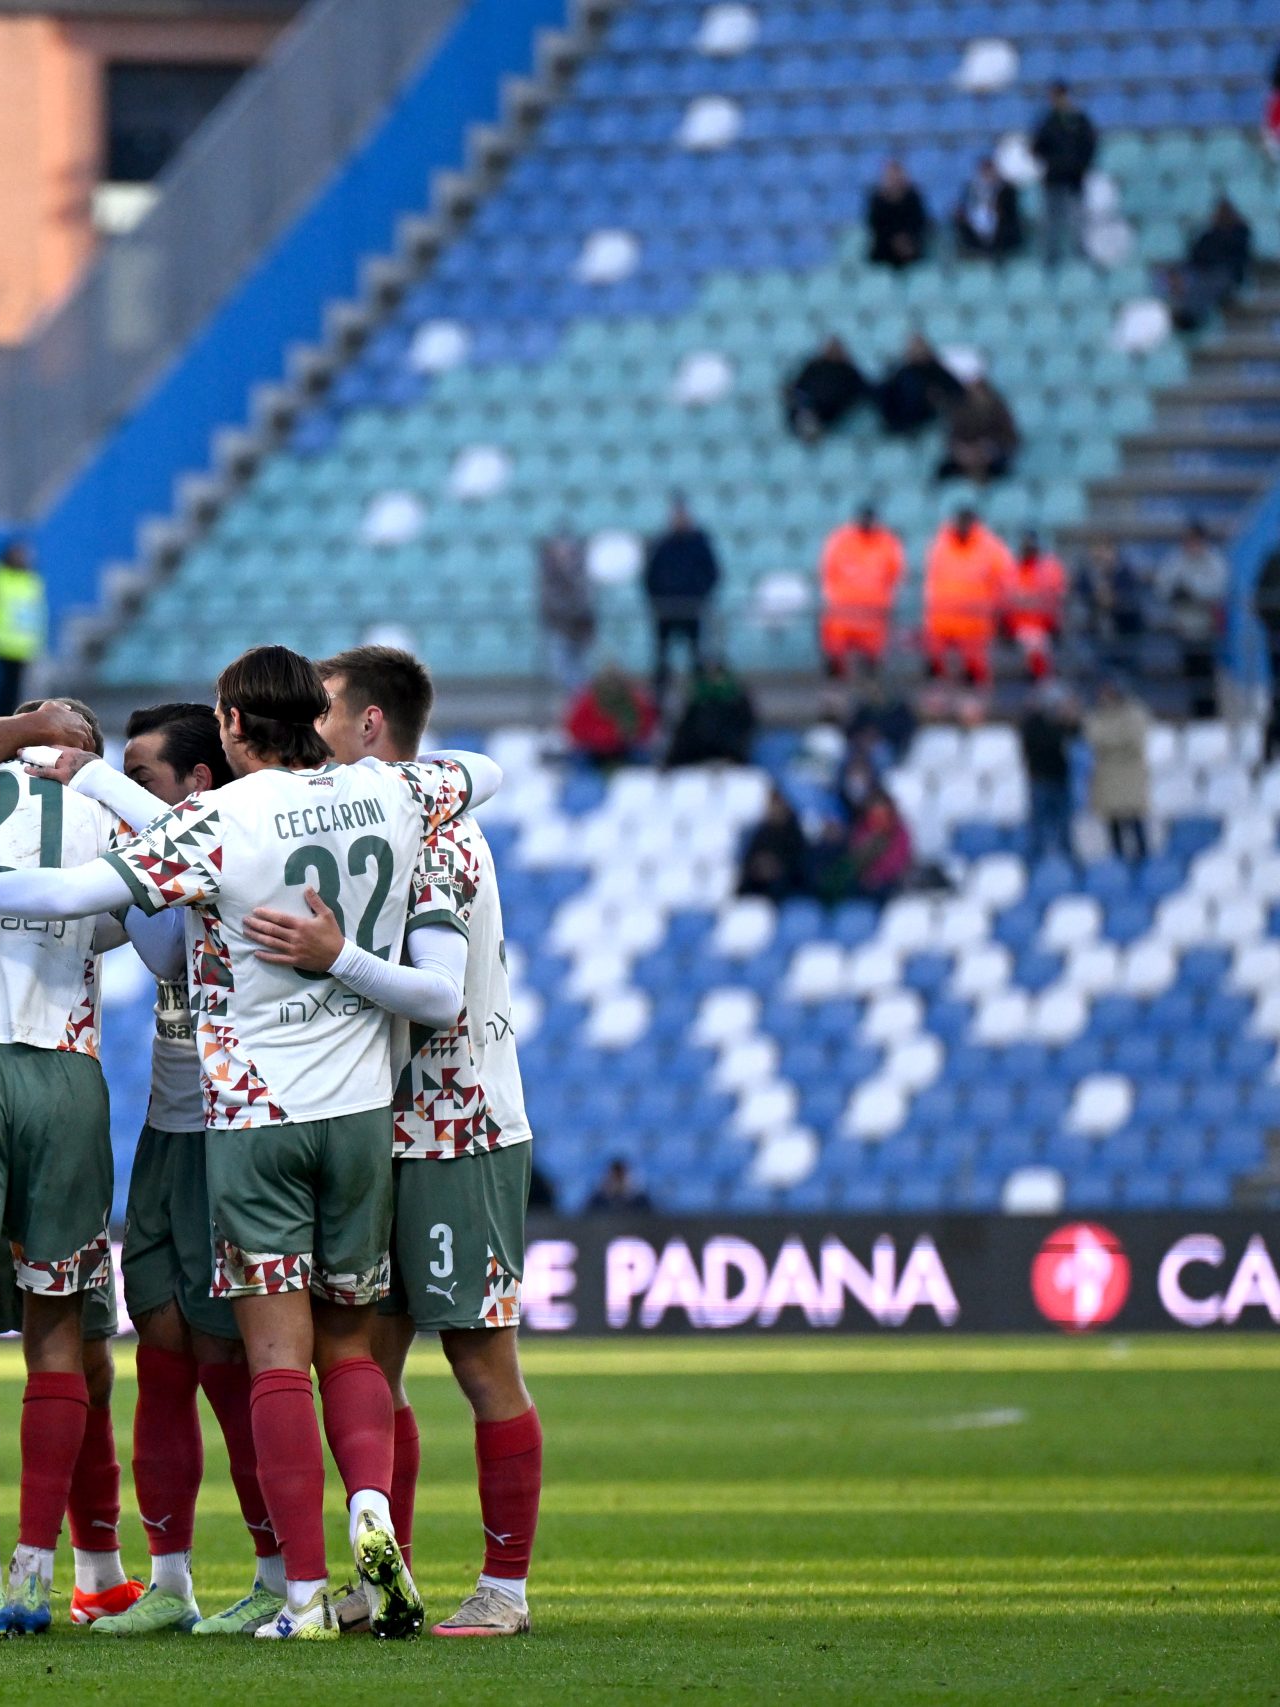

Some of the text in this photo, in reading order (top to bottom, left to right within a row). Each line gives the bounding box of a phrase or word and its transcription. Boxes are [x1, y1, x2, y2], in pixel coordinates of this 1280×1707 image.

[274, 798, 386, 840] CECCARONI
[284, 834, 394, 980] 32
[430, 1223, 454, 1278] 3
[605, 1232, 961, 1330] PADANA
